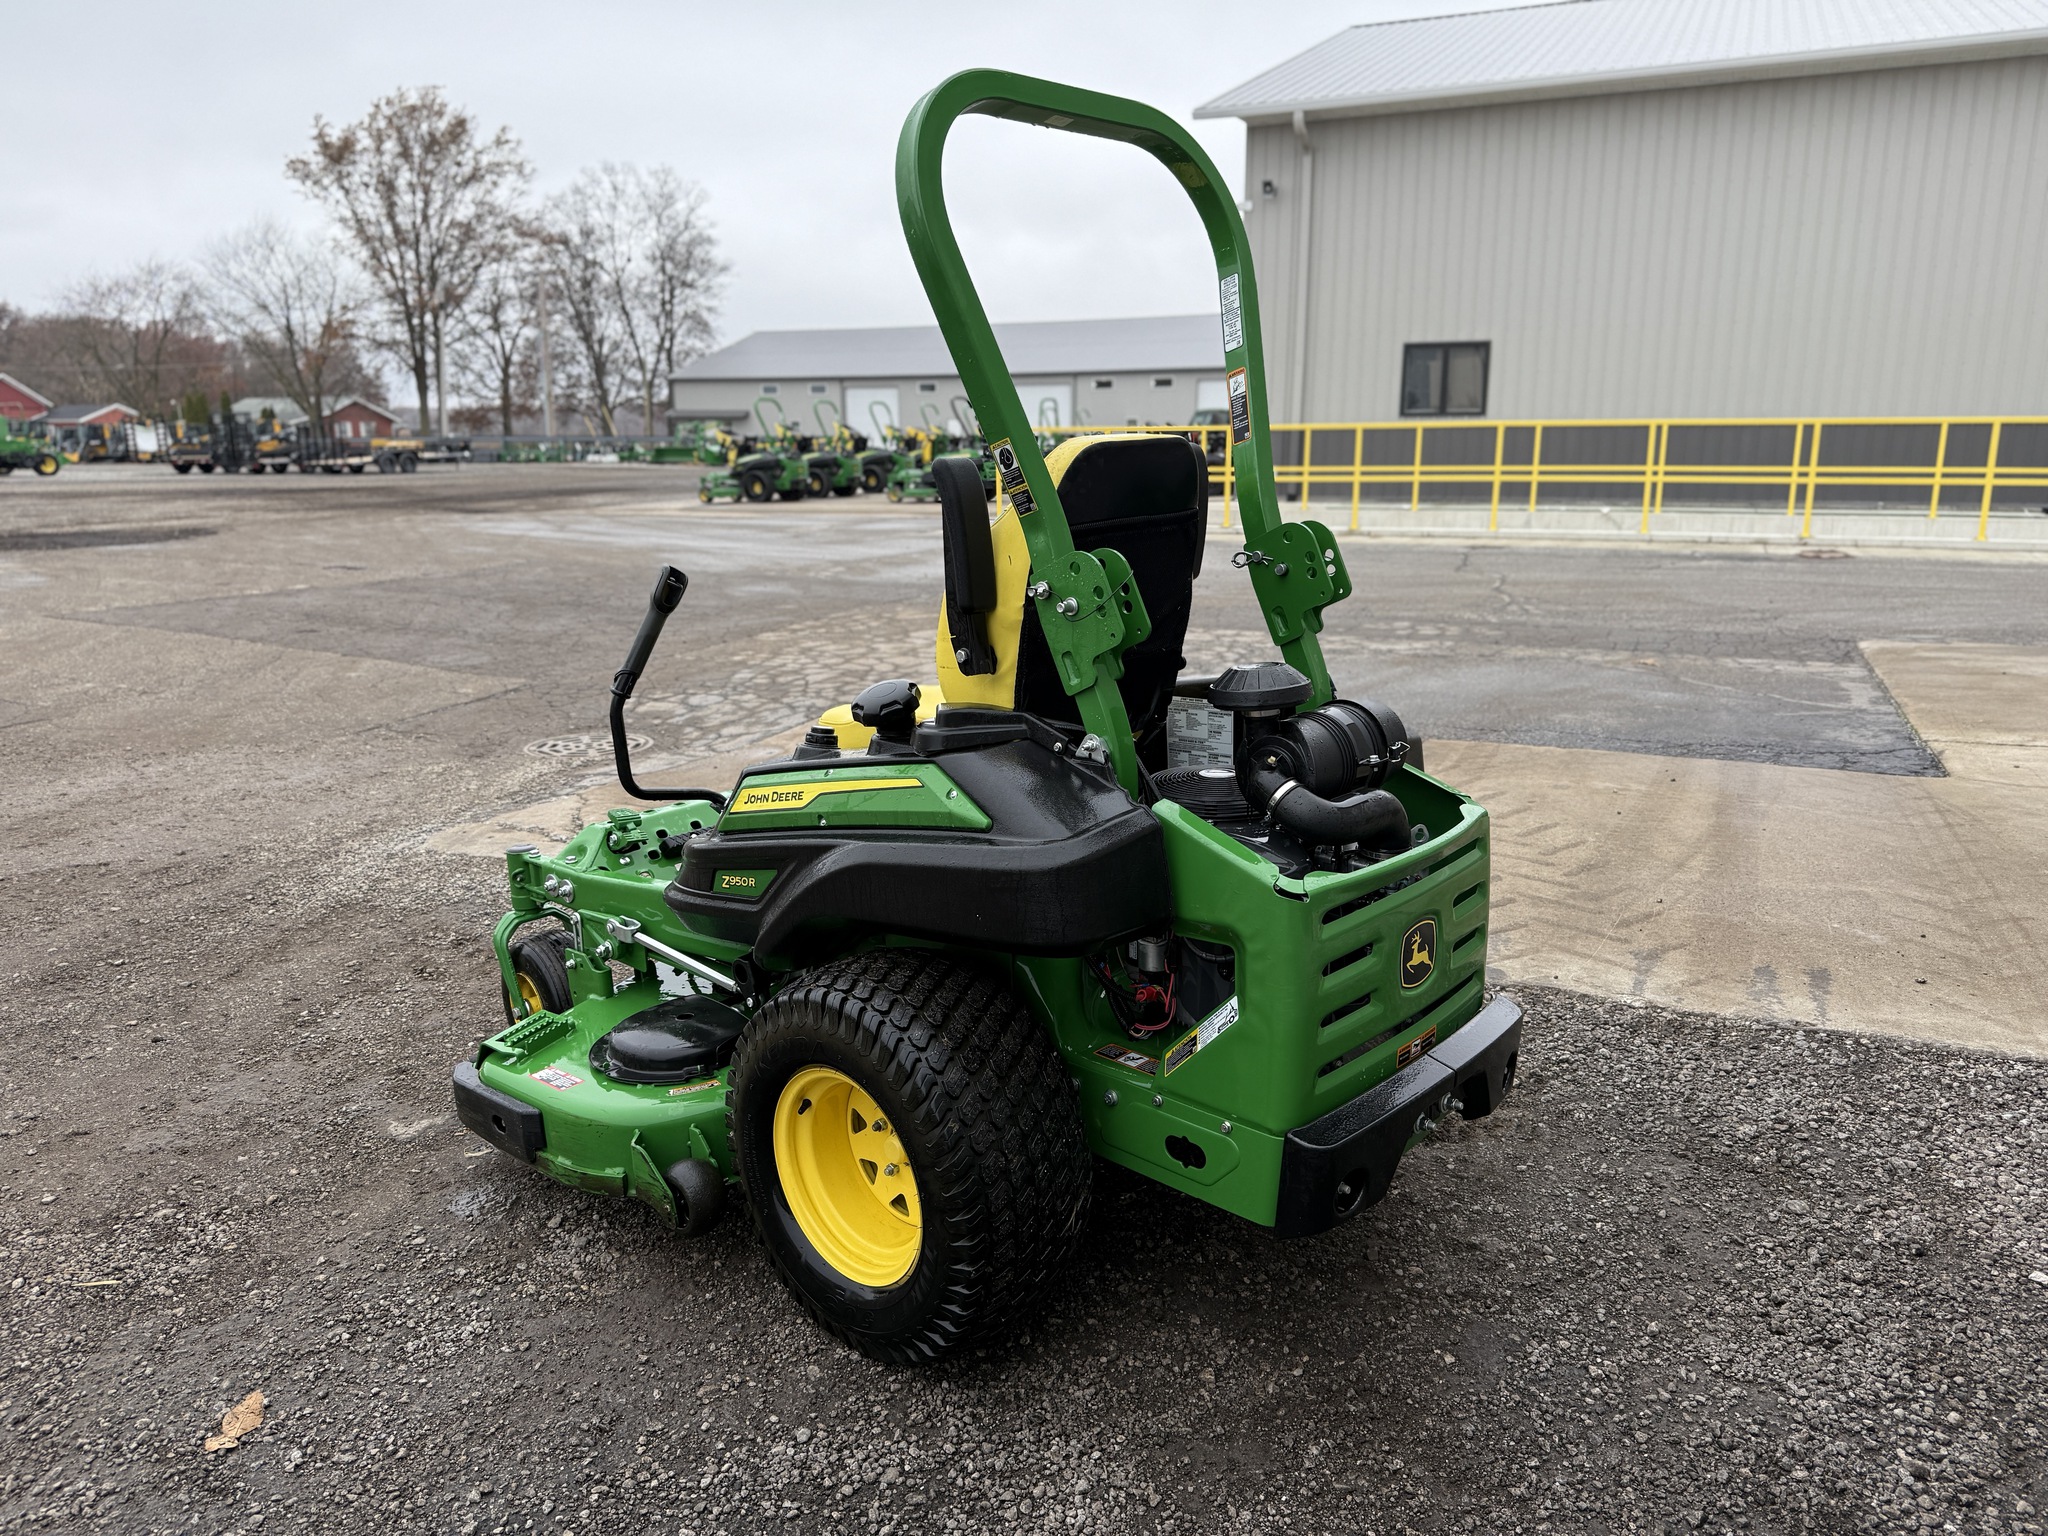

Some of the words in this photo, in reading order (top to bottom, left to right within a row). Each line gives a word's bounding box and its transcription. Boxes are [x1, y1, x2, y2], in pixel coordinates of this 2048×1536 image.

[744, 793, 770, 804] JOHN
[771, 791, 805, 802] DEERE
[721, 875, 756, 888] Z950R
